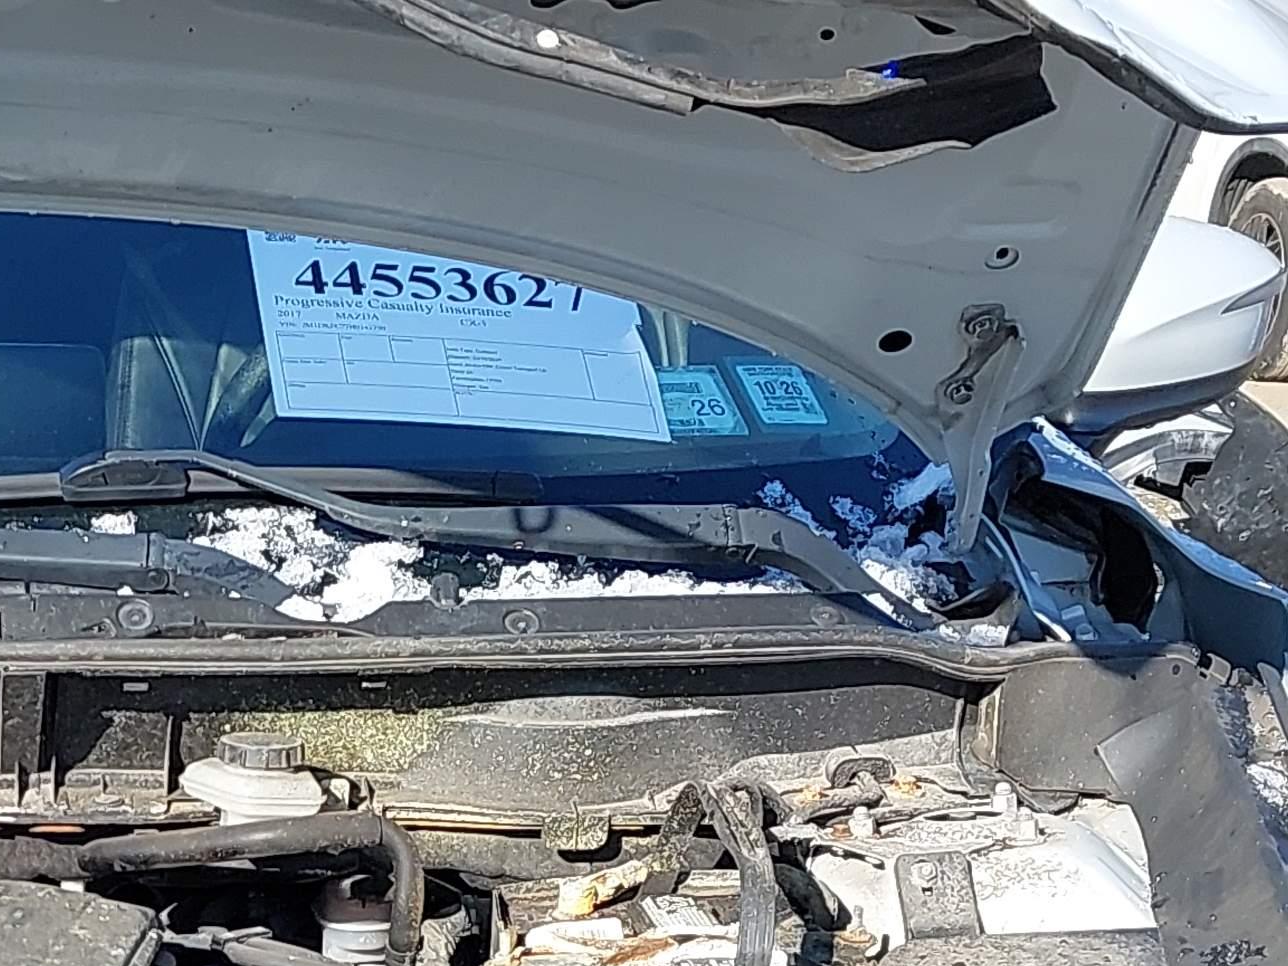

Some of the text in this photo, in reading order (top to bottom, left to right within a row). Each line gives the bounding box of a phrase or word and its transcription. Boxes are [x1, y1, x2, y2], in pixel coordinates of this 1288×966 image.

[294, 259, 583, 312] 44553627
[273, 294, 512, 318] Progressive Casualty Insurance
[277, 309, 302, 319] 2017
[335, 311, 380, 321] MAZDA
[691, 398, 726, 417] 26
